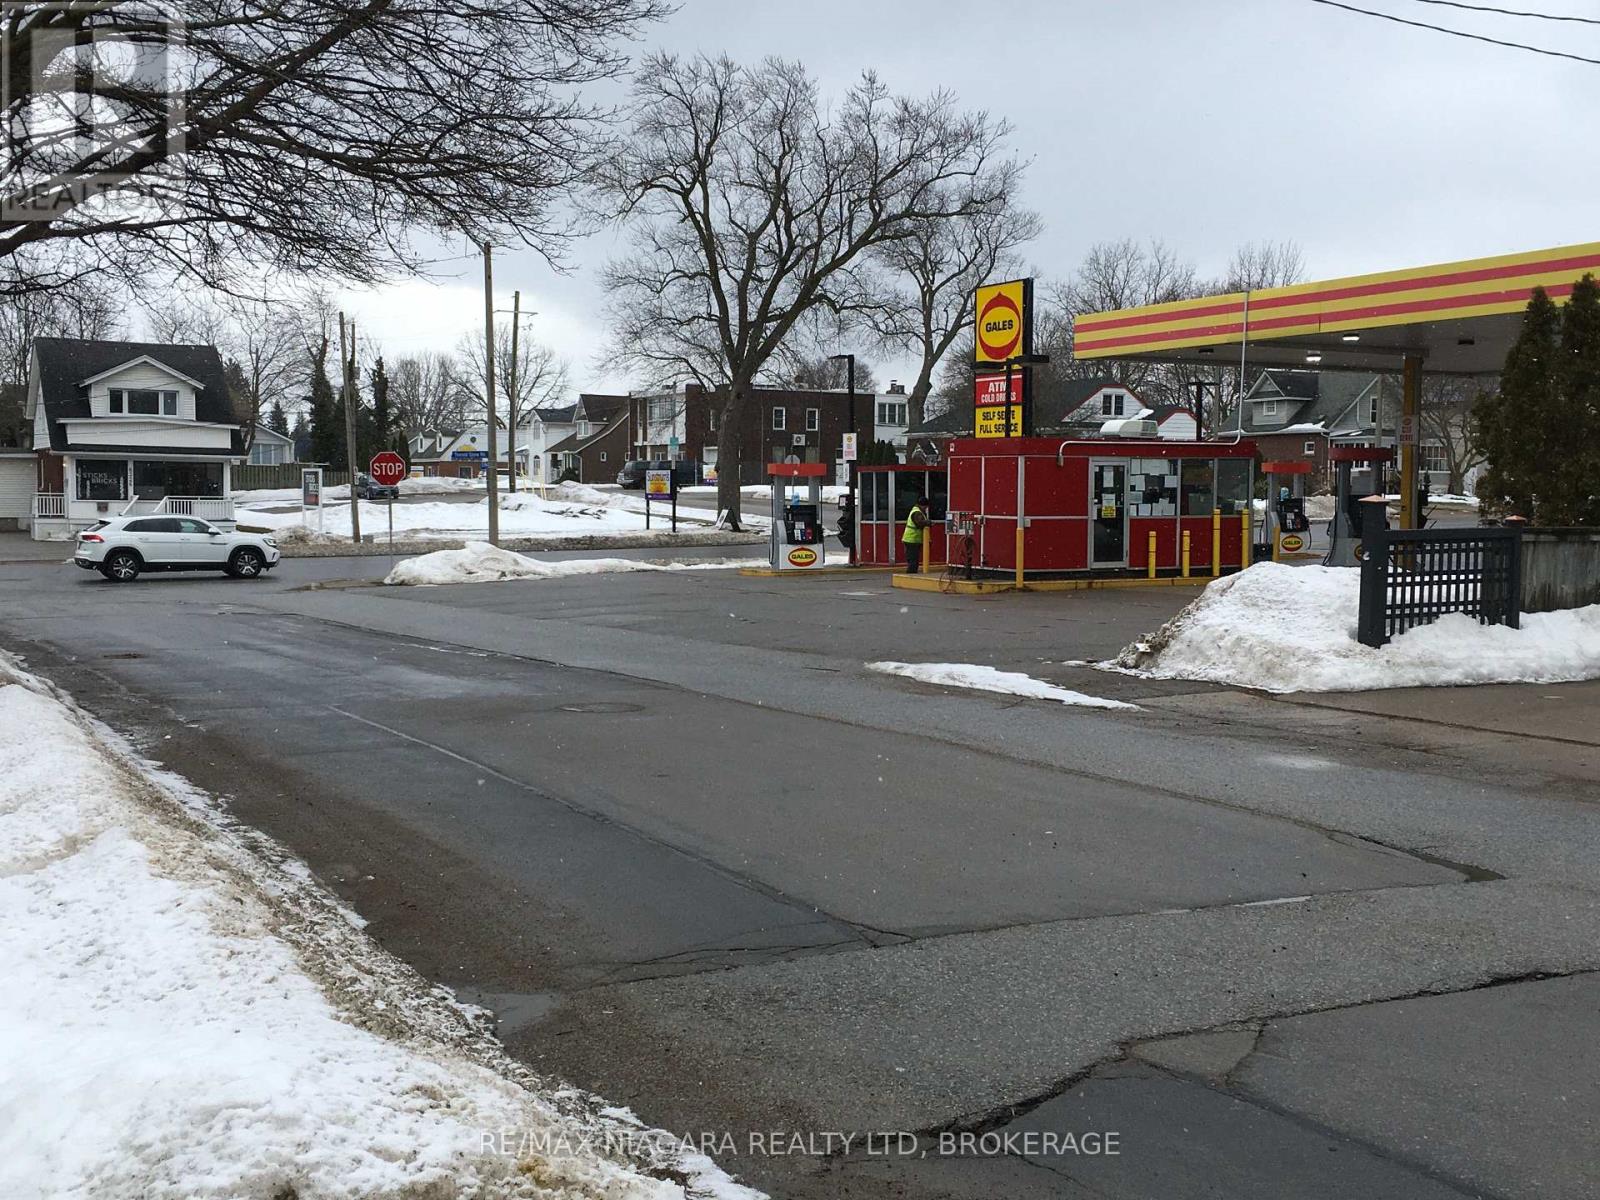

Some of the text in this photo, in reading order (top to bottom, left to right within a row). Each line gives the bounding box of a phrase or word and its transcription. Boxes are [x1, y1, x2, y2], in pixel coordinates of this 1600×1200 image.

[986, 320, 1013, 333] GALES
[981, 393, 996, 403] COLD
[982, 410, 1015, 421] SELF SEE
[980, 422, 1018, 434] FULL SERCE
[373, 462, 403, 476] STOP
